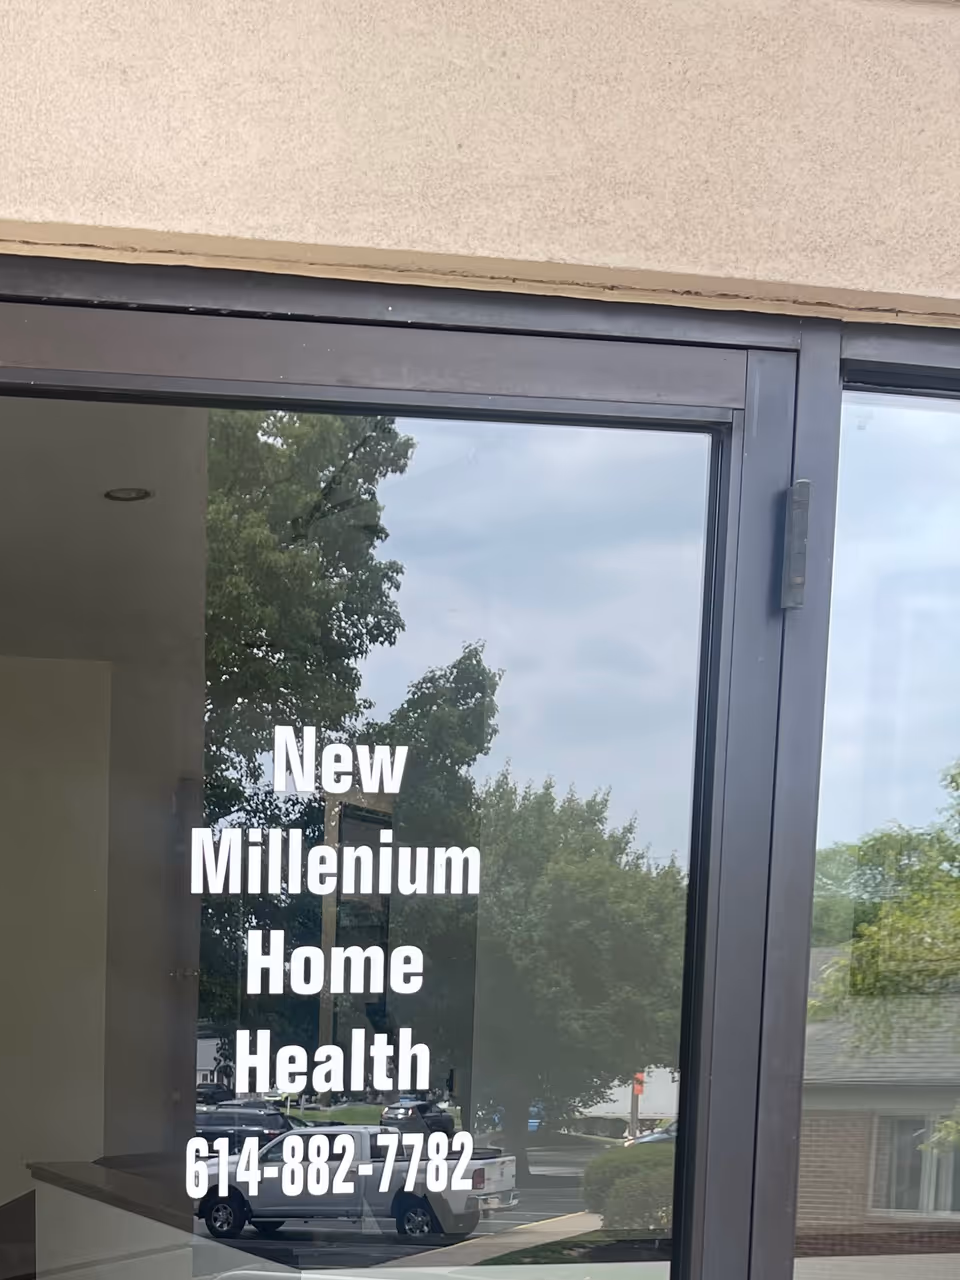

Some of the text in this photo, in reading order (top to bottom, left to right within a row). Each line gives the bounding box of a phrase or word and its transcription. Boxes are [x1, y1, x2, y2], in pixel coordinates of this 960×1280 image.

[272, 725, 409, 794] New
[190, 827, 481, 895] Millenium
[246, 929, 424, 995] Home
[235, 1028, 430, 1094] Health
[185, 1131, 474, 1199] 614-882-7782
